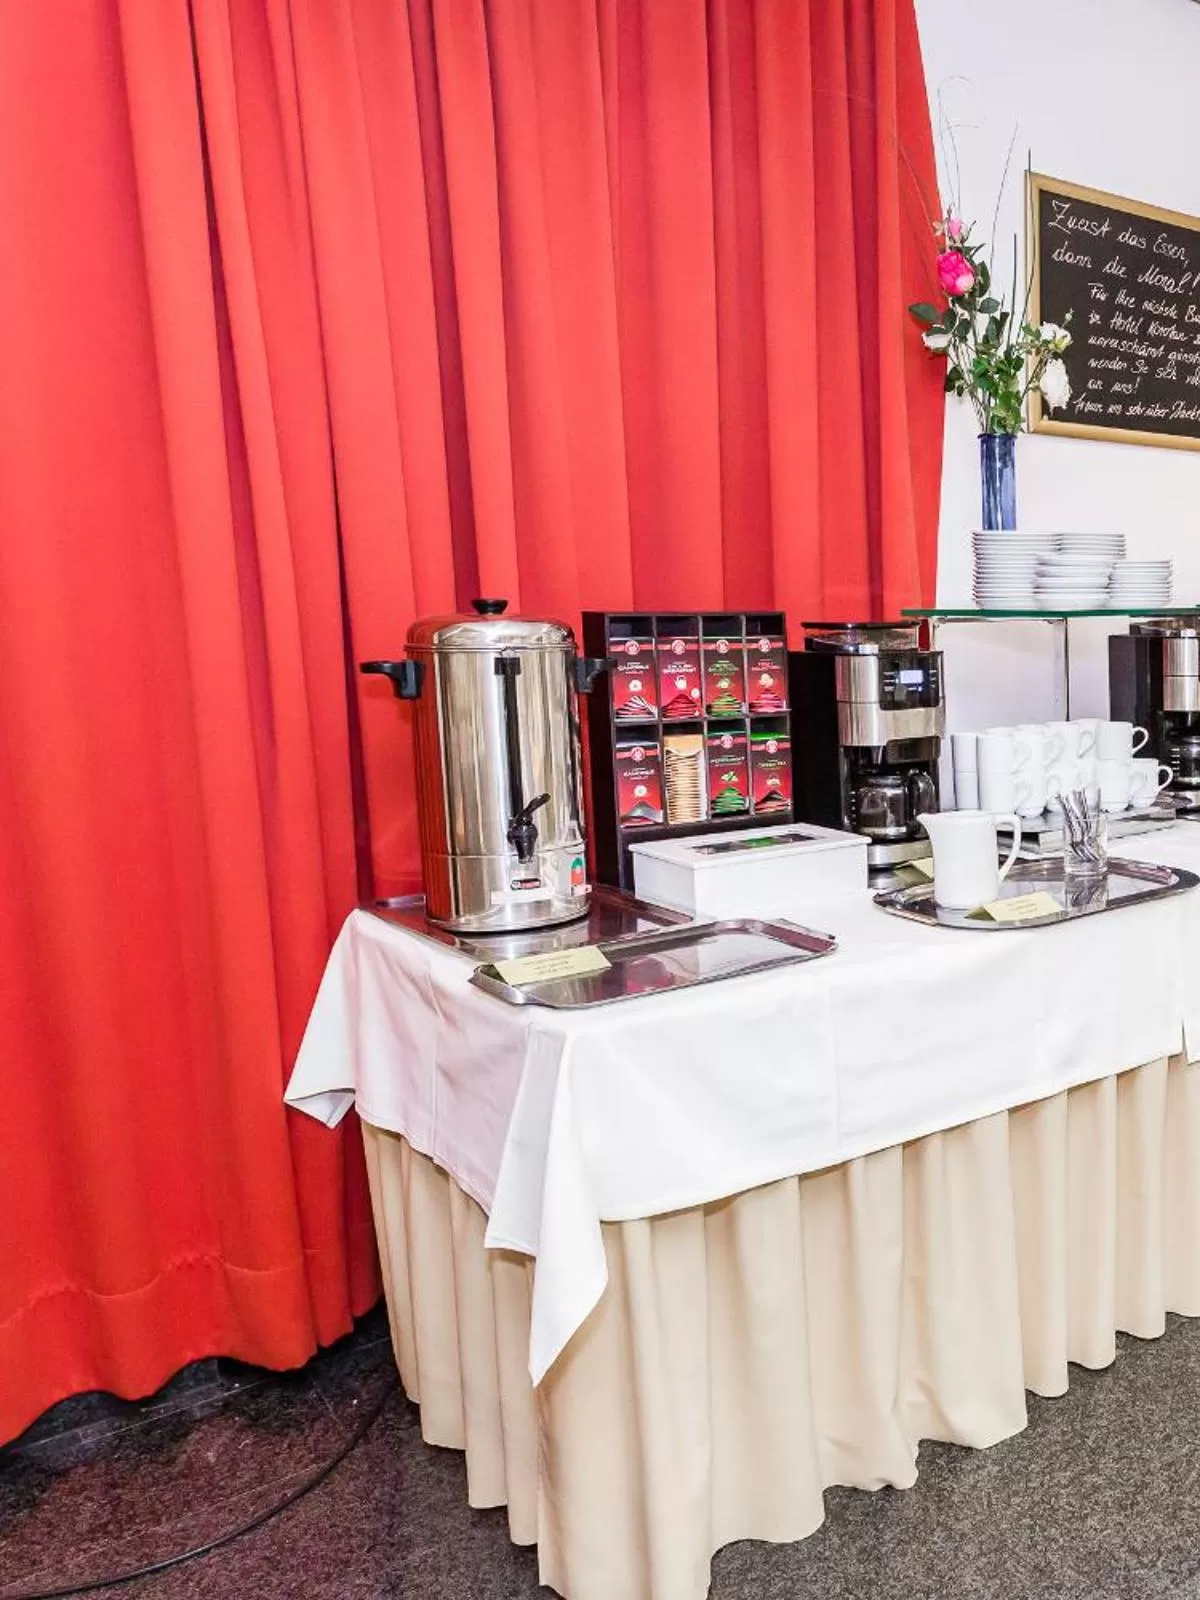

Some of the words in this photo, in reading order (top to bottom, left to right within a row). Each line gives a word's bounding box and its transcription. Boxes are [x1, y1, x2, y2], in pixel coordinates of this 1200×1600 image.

[1117, 228, 1146, 248] das
[1052, 242, 1093, 268] dann
[1103, 256, 1127, 278] die
[1110, 311, 1144, 335] Hotel
